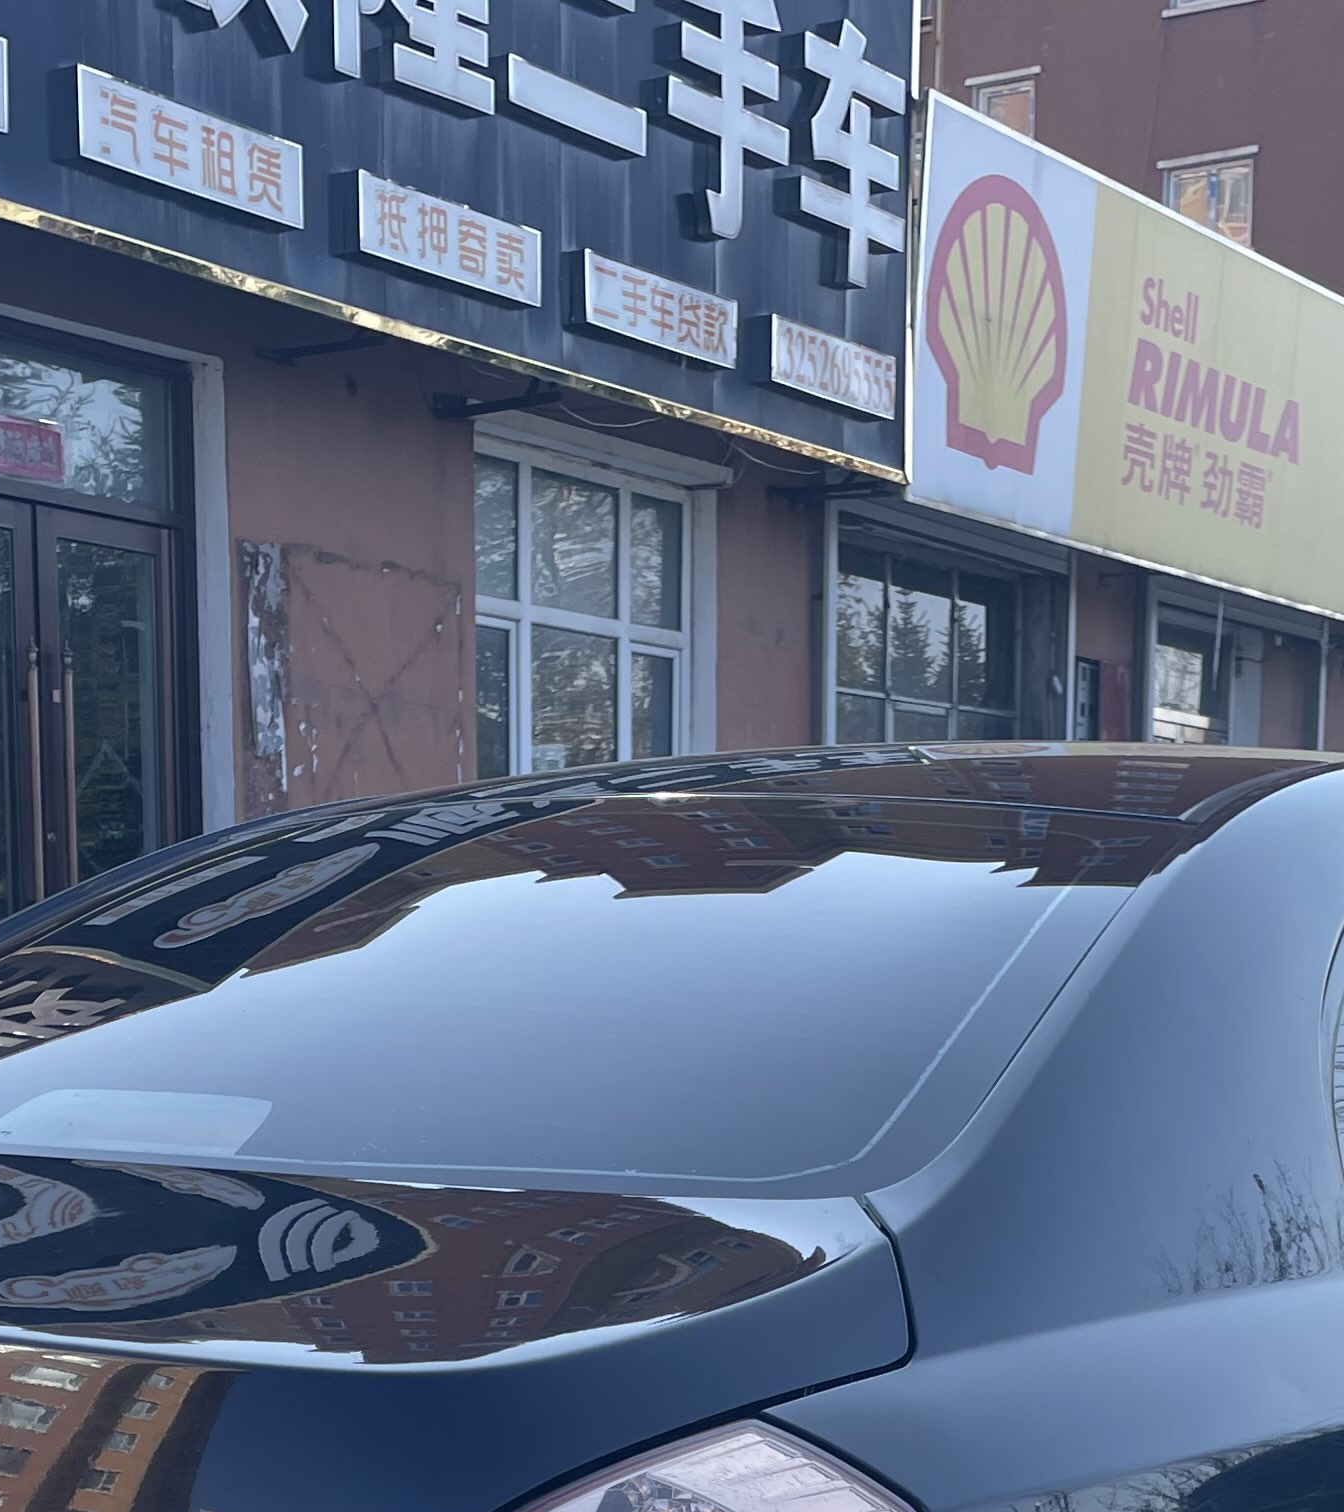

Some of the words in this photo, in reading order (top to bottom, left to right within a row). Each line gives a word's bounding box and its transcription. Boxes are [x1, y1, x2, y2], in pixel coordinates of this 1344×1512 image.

[99, 88, 283, 214] 汽车租赁
[376, 190, 527, 292] 抵押寄卖
[593, 264, 729, 356] 二手车贷款
[1140, 276, 1199, 344] Shell
[1127, 337, 1300, 464] RIMULA
